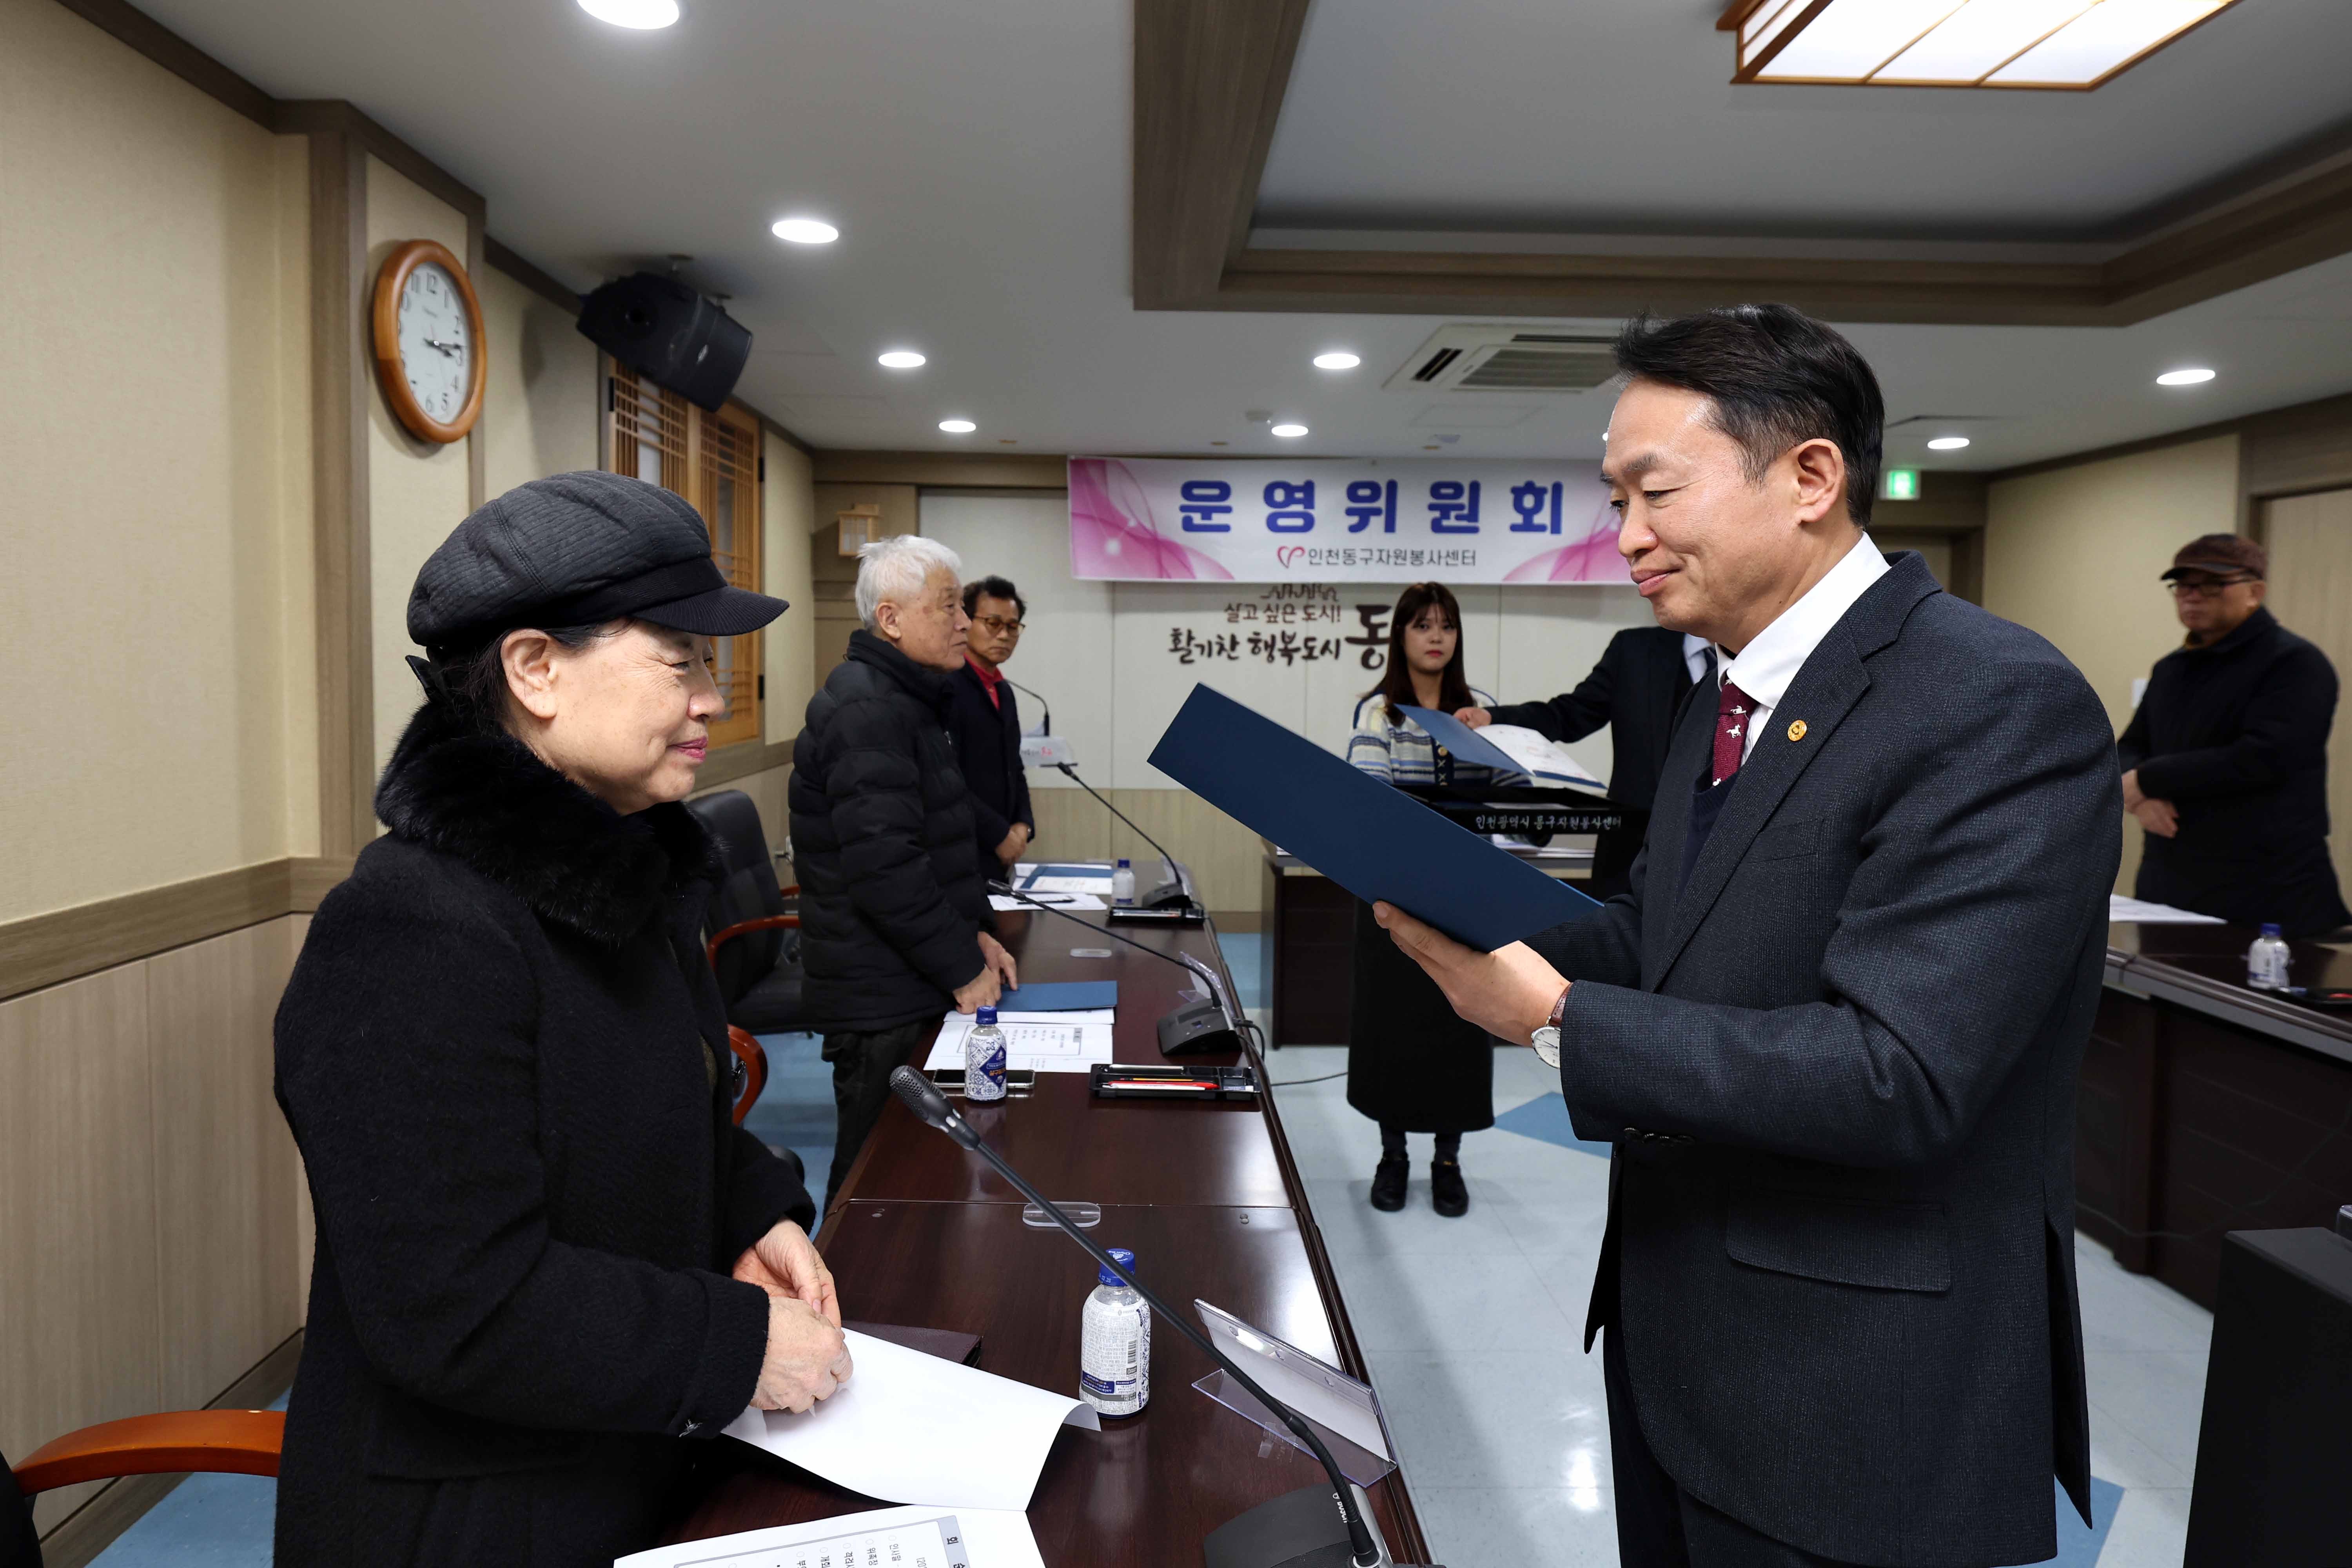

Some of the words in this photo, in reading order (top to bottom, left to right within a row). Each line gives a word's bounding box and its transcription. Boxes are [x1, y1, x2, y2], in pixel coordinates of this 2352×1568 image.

[425, 394, 433, 413] 6
[441, 392, 448, 411] 5
[1179, 481, 1563, 534] 운영위원회
[1308, 548, 1476, 566] 인천동구자원봉사센터
[1224, 603, 1258, 622] 살고
[1263, 603, 1297, 624] 싶은
[1302, 604, 1341, 622] 도시!
[1169, 628, 1240, 664] 활기찬
[1247, 629, 1341, 666] 행복도시
[947, 1536, 959, 1544] 회
[866, 1548, 878, 1566] 위촉장
[889, 1544, 901, 1561] 인사말
